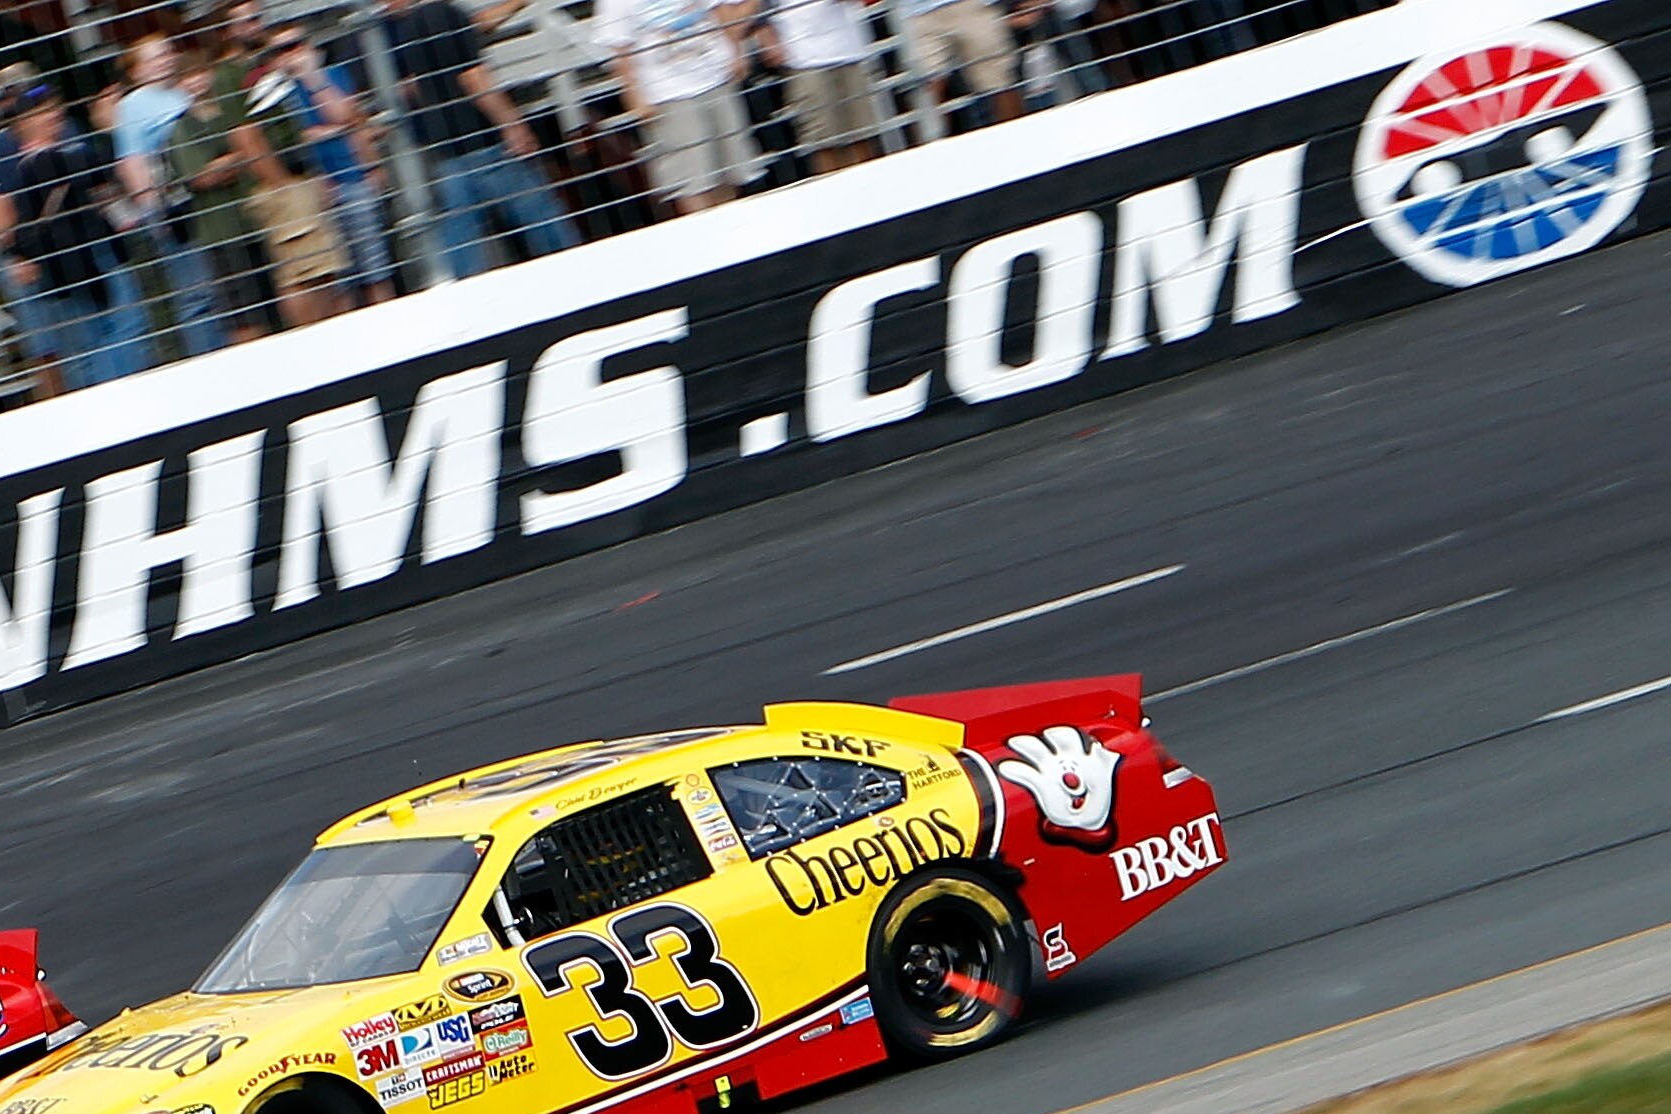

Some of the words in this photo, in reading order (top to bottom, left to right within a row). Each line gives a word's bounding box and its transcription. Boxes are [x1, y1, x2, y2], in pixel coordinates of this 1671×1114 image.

[801, 731, 891, 758] SKF
[907, 767, 926, 780] THE
[912, 768, 962, 790] HARTFORD
[764, 807, 966, 917] Cheerios
[1108, 811, 1223, 901] BB&T
[520, 901, 761, 1082] 33
[342, 1016, 396, 1043] Holley
[436, 1015, 471, 1043] USG
[485, 1029, 527, 1054] O'Reilly
[357, 1038, 400, 1077] 3M
[426, 1054, 482, 1082] CRAFTSMAN
[238, 1052, 336, 1097] GOODYEAR
[379, 1078, 422, 1101] TISSOT
[429, 1070, 485, 1109] JEGS
